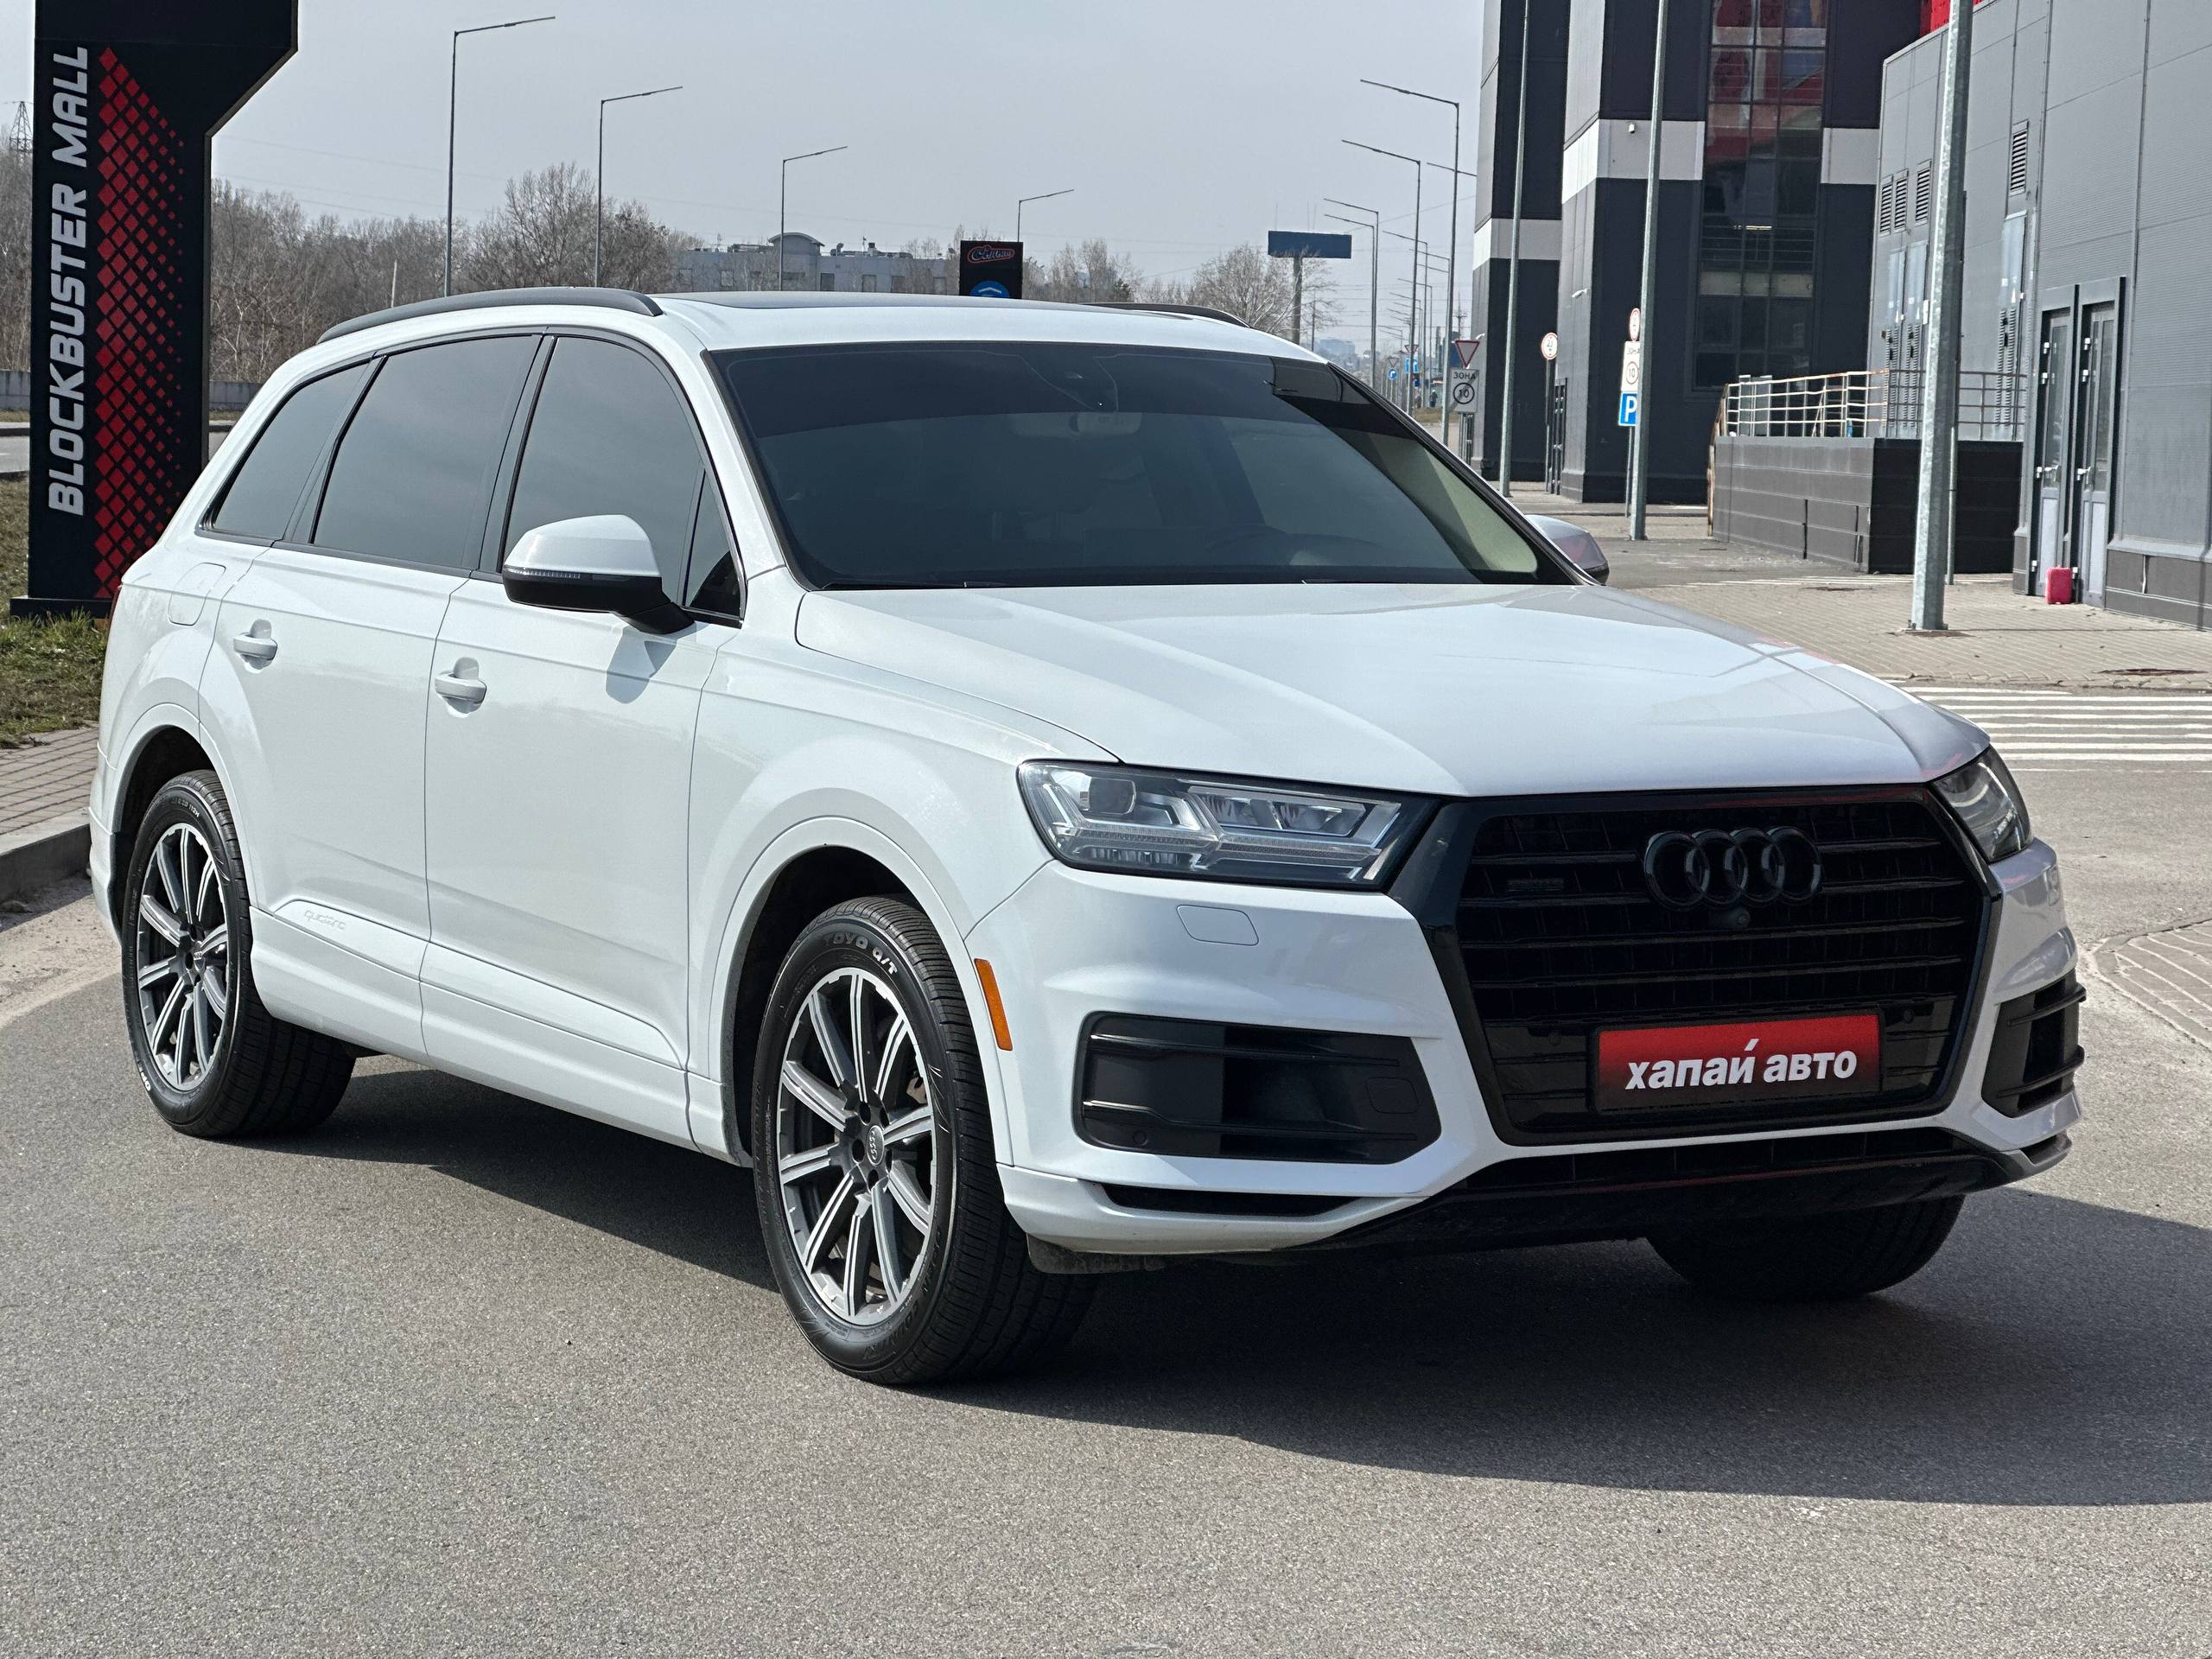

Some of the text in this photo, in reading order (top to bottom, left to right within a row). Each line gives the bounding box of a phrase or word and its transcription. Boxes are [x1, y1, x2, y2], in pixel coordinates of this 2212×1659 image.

[48, 47, 88, 516] BLOCKBUSTER MALL
[1459, 388, 1469, 398] 10
[1624, 396, 1637, 422] P
[822, 932, 868, 950] TOYO
[1625, 1039, 1857, 1090] хапай авто
